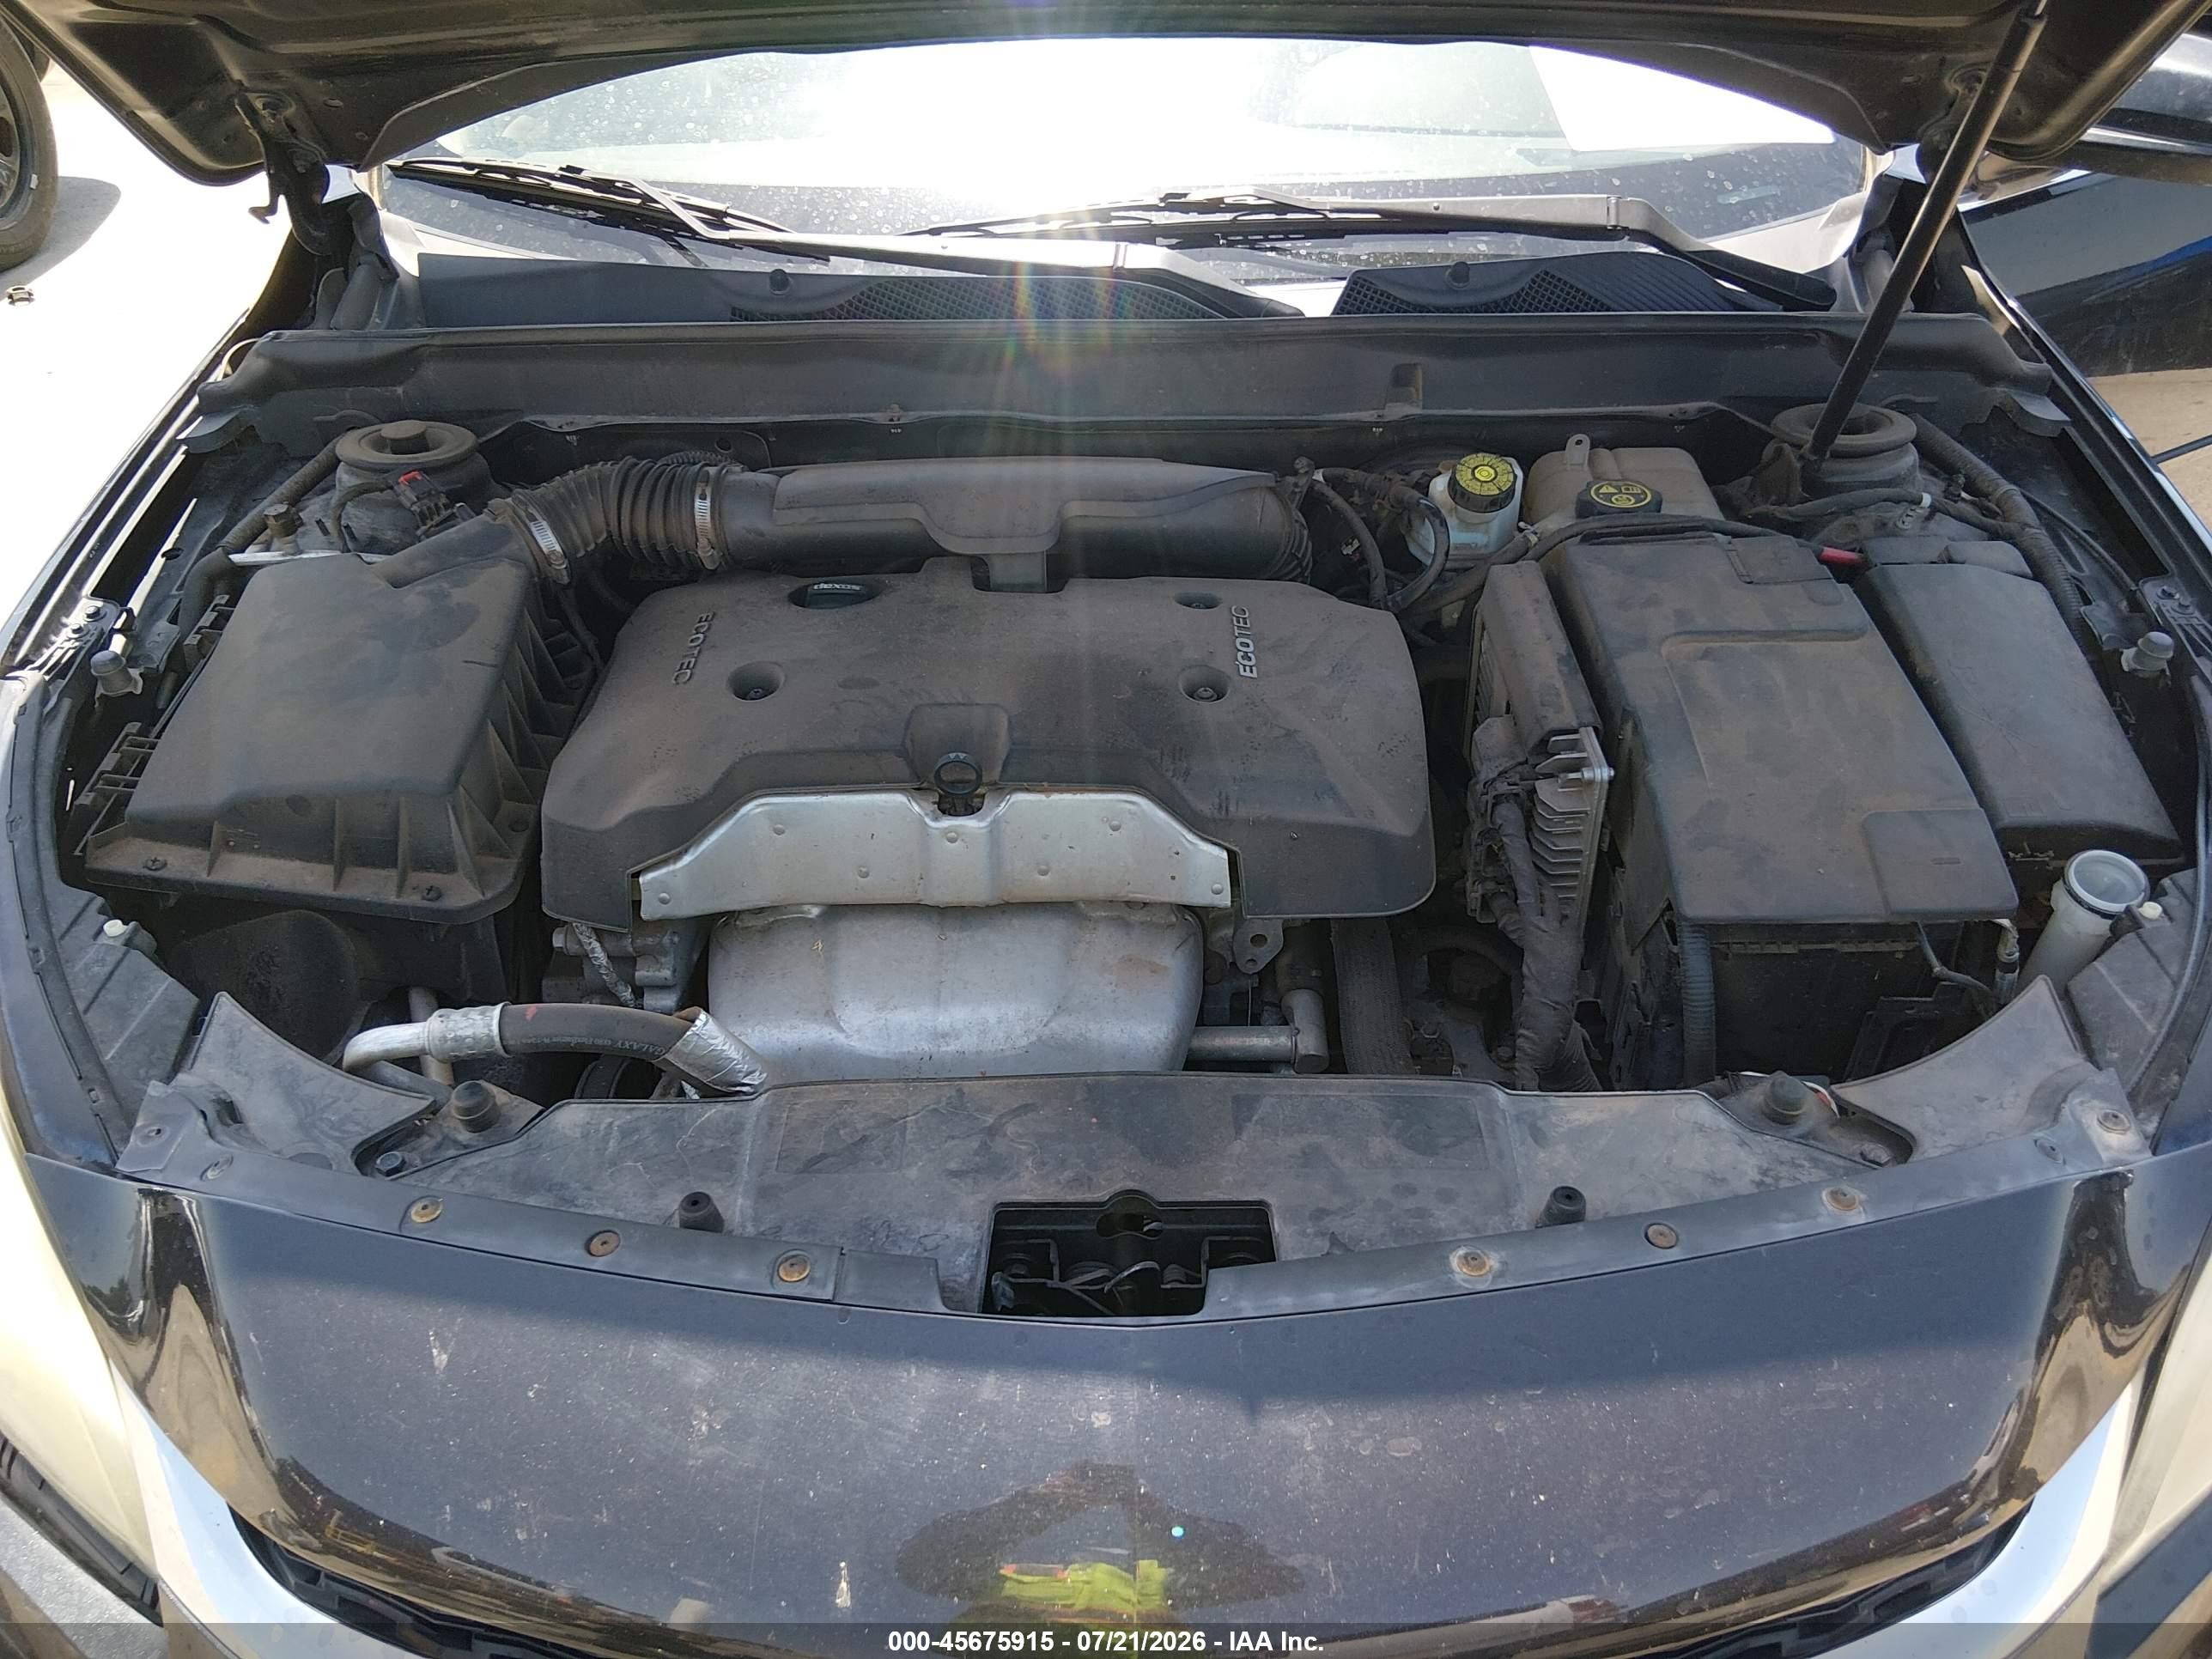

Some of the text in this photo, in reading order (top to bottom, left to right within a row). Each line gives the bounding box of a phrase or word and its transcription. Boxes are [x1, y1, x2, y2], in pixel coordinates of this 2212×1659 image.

[672, 611, 714, 685] ECOTEC
[1231, 605, 1257, 678] ECOTEC
[615, 1039, 667, 1055] GALAXY
